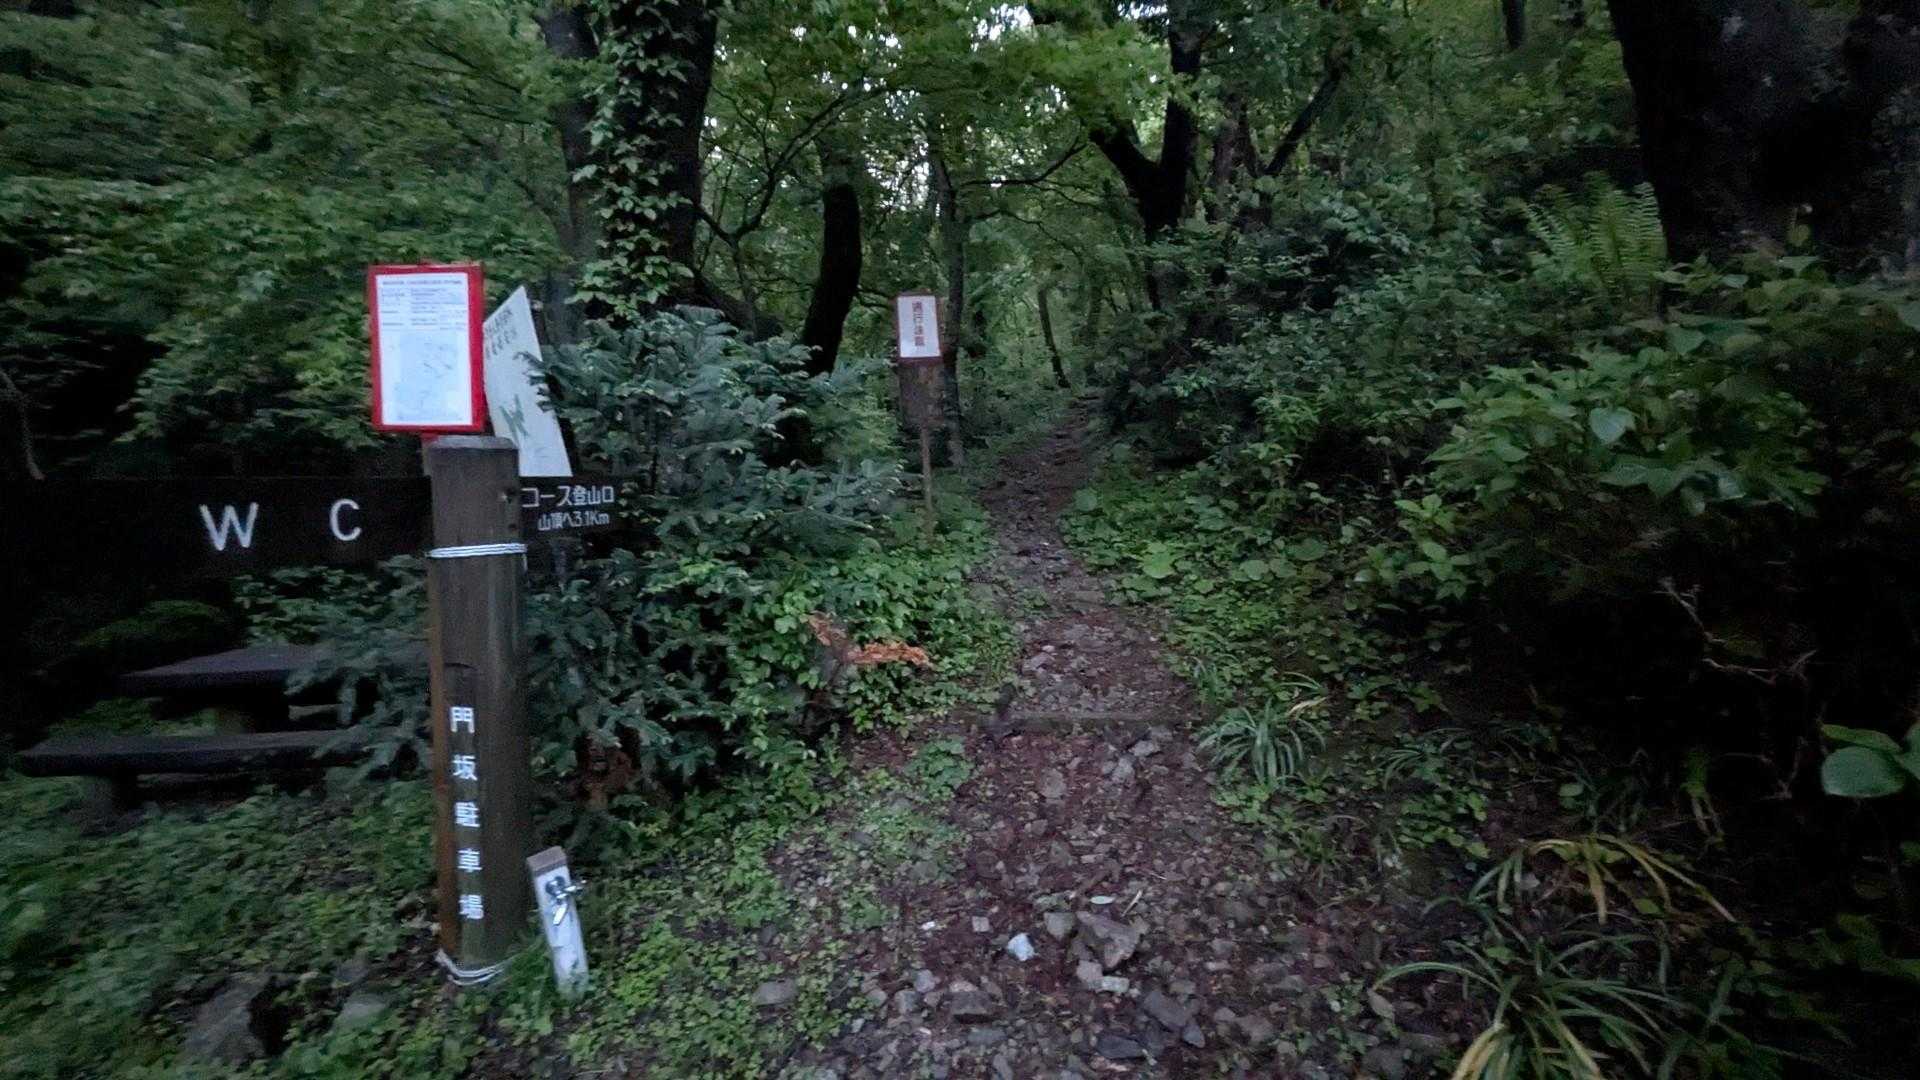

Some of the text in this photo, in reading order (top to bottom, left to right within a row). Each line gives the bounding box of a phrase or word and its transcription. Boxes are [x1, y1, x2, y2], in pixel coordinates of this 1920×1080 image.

[521, 485, 615, 508] コース登山口
[449, 705, 485, 920] 門坂駐車場
